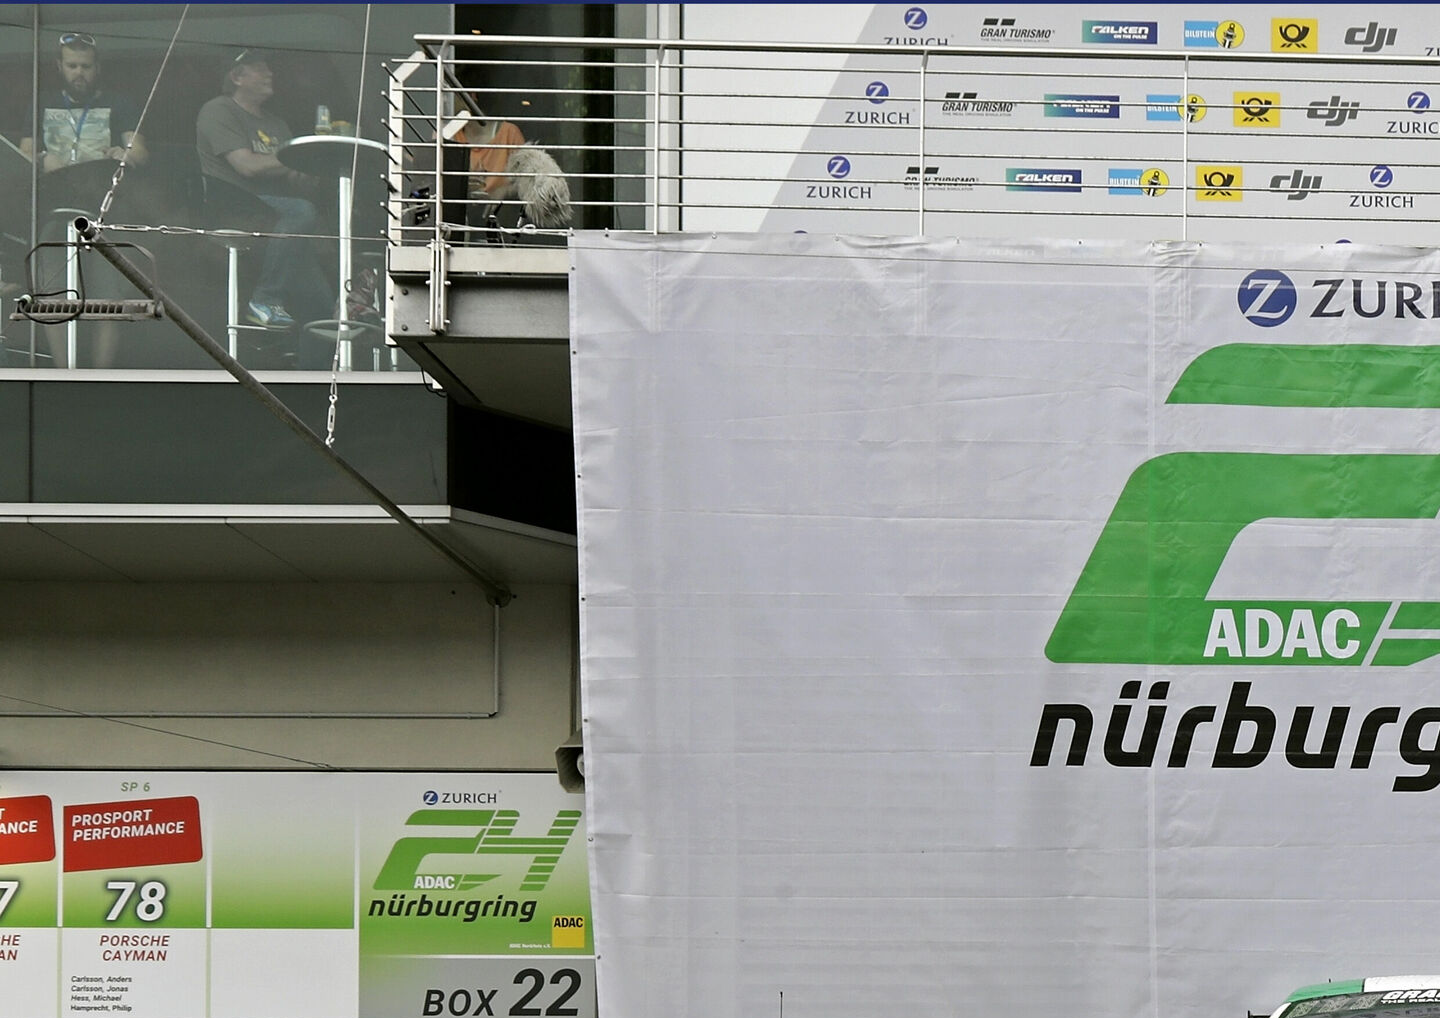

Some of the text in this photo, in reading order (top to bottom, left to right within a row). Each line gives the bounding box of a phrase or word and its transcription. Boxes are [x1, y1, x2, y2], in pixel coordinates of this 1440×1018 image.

[981, 28, 1051, 39] GRAN TURISMO
[844, 112, 910, 124] ZURICH
[806, 186, 871, 199] ZURICH
[1349, 195, 1414, 208] ZURICH
[1203, 608, 1362, 659] ADAC
[121, 782, 151, 792] SP 6
[442, 792, 497, 804] ZURICH
[72, 809, 152, 827] PROSPORT
[73, 821, 185, 841] PERFORMANCE
[414, 876, 455, 889] ADAC
[105, 880, 168, 923] 78
[368, 893, 538, 923] nürburgring
[553, 917, 583, 928] ADAC
[100, 935, 171, 947] PORSCHE
[102, 950, 168, 961] CAYMAN
[107, 975, 132, 983] Anders
[423, 968, 581, 1016] BOX 22
